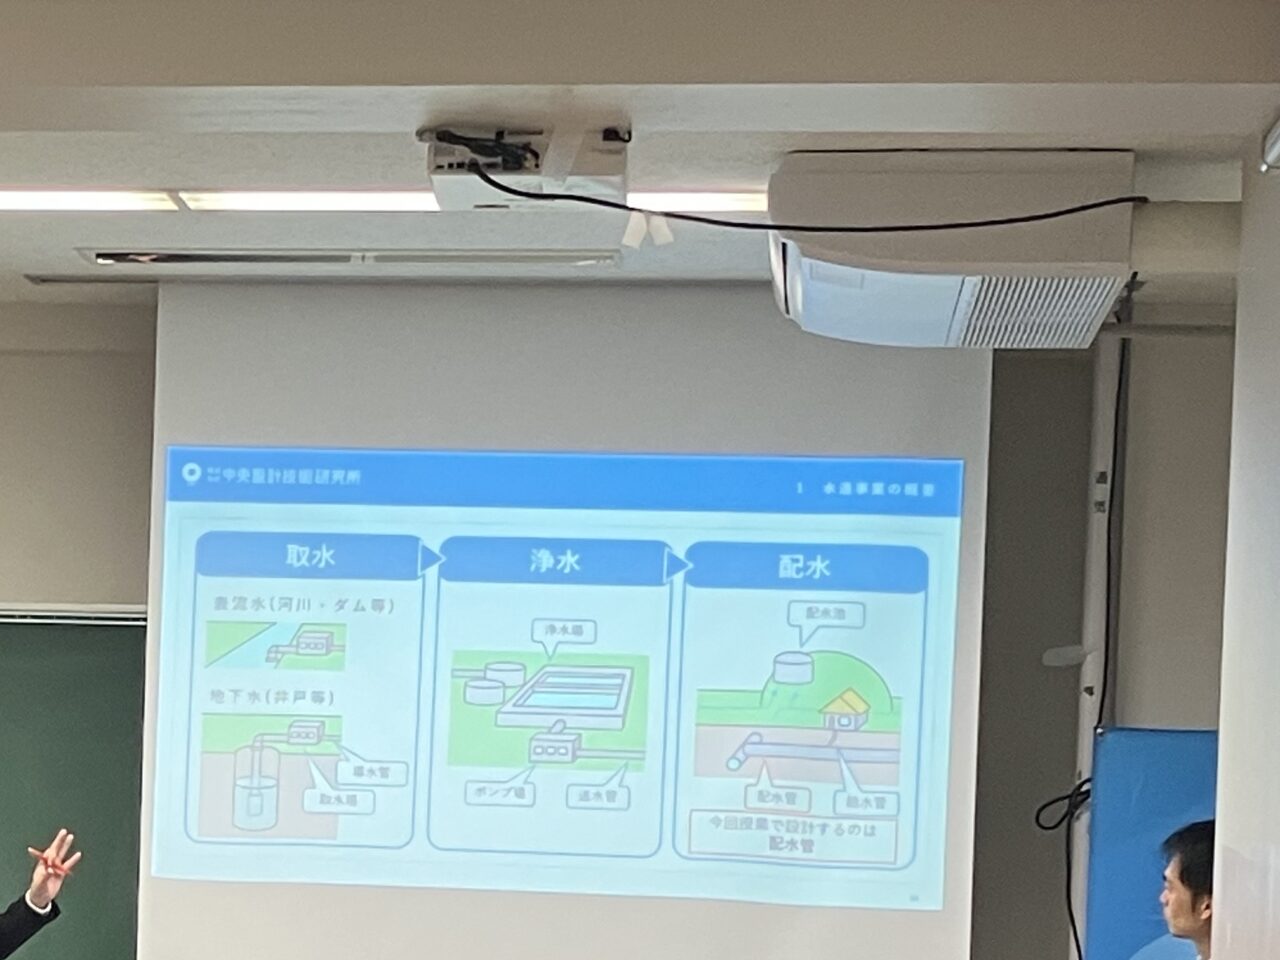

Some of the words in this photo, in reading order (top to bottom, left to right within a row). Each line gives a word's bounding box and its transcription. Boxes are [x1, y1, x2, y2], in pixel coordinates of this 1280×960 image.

[285, 544, 336, 568] 取水
[530, 548, 580, 573] 浄水
[778, 554, 831, 579] 配水
